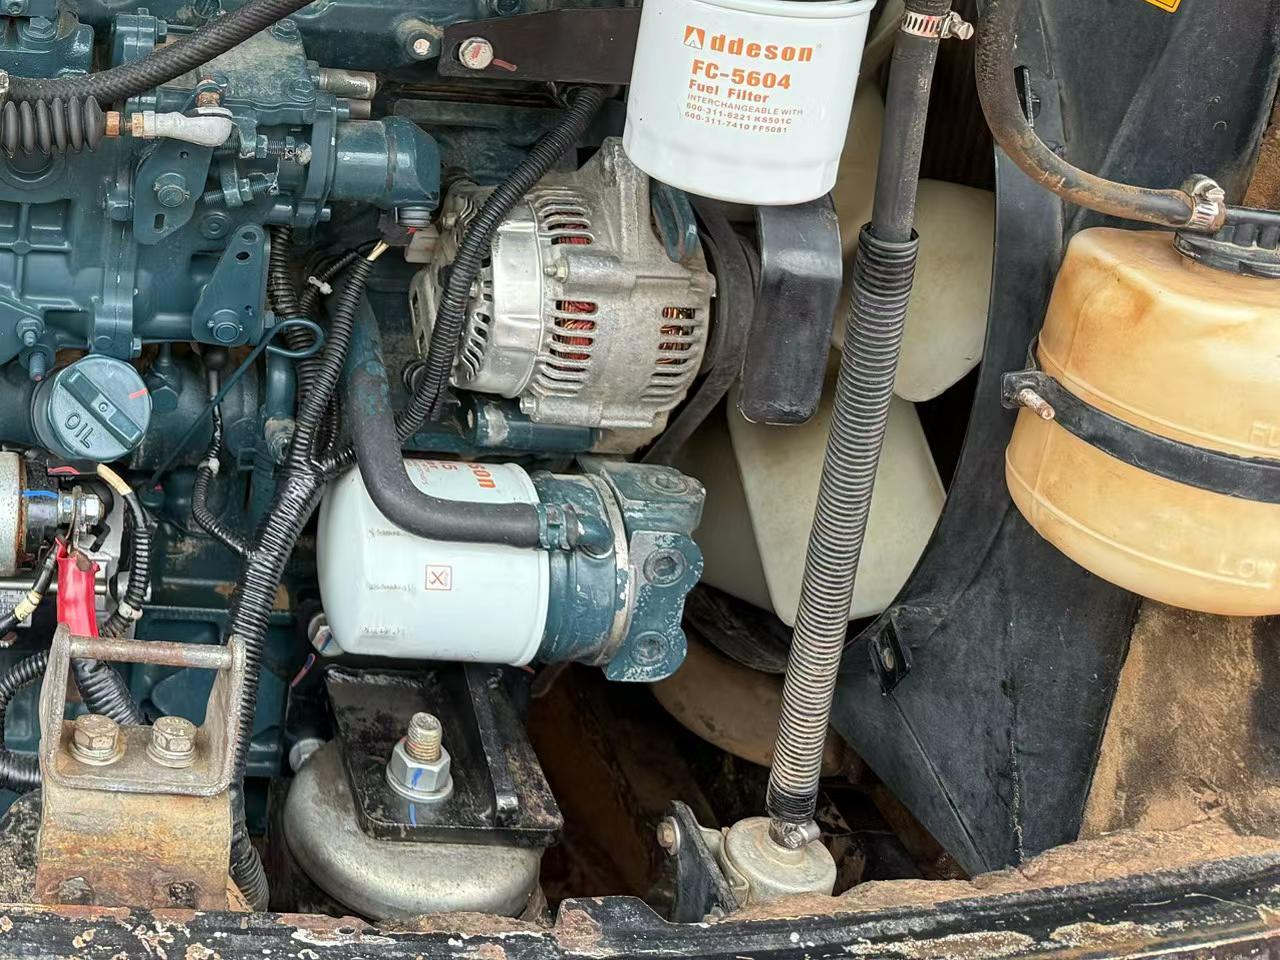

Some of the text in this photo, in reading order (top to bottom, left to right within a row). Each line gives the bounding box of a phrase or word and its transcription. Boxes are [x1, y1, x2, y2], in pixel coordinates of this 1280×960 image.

[692, 59, 791, 90] FC-5604
[688, 79, 769, 103] Fuel Filter
[686, 103, 751, 121] 600-311-6221
[687, 94, 803, 116] INTERCHANGEABLE WITH
[684, 112, 750, 130] 600-311-7410
[64, 412, 94, 449] OIL
